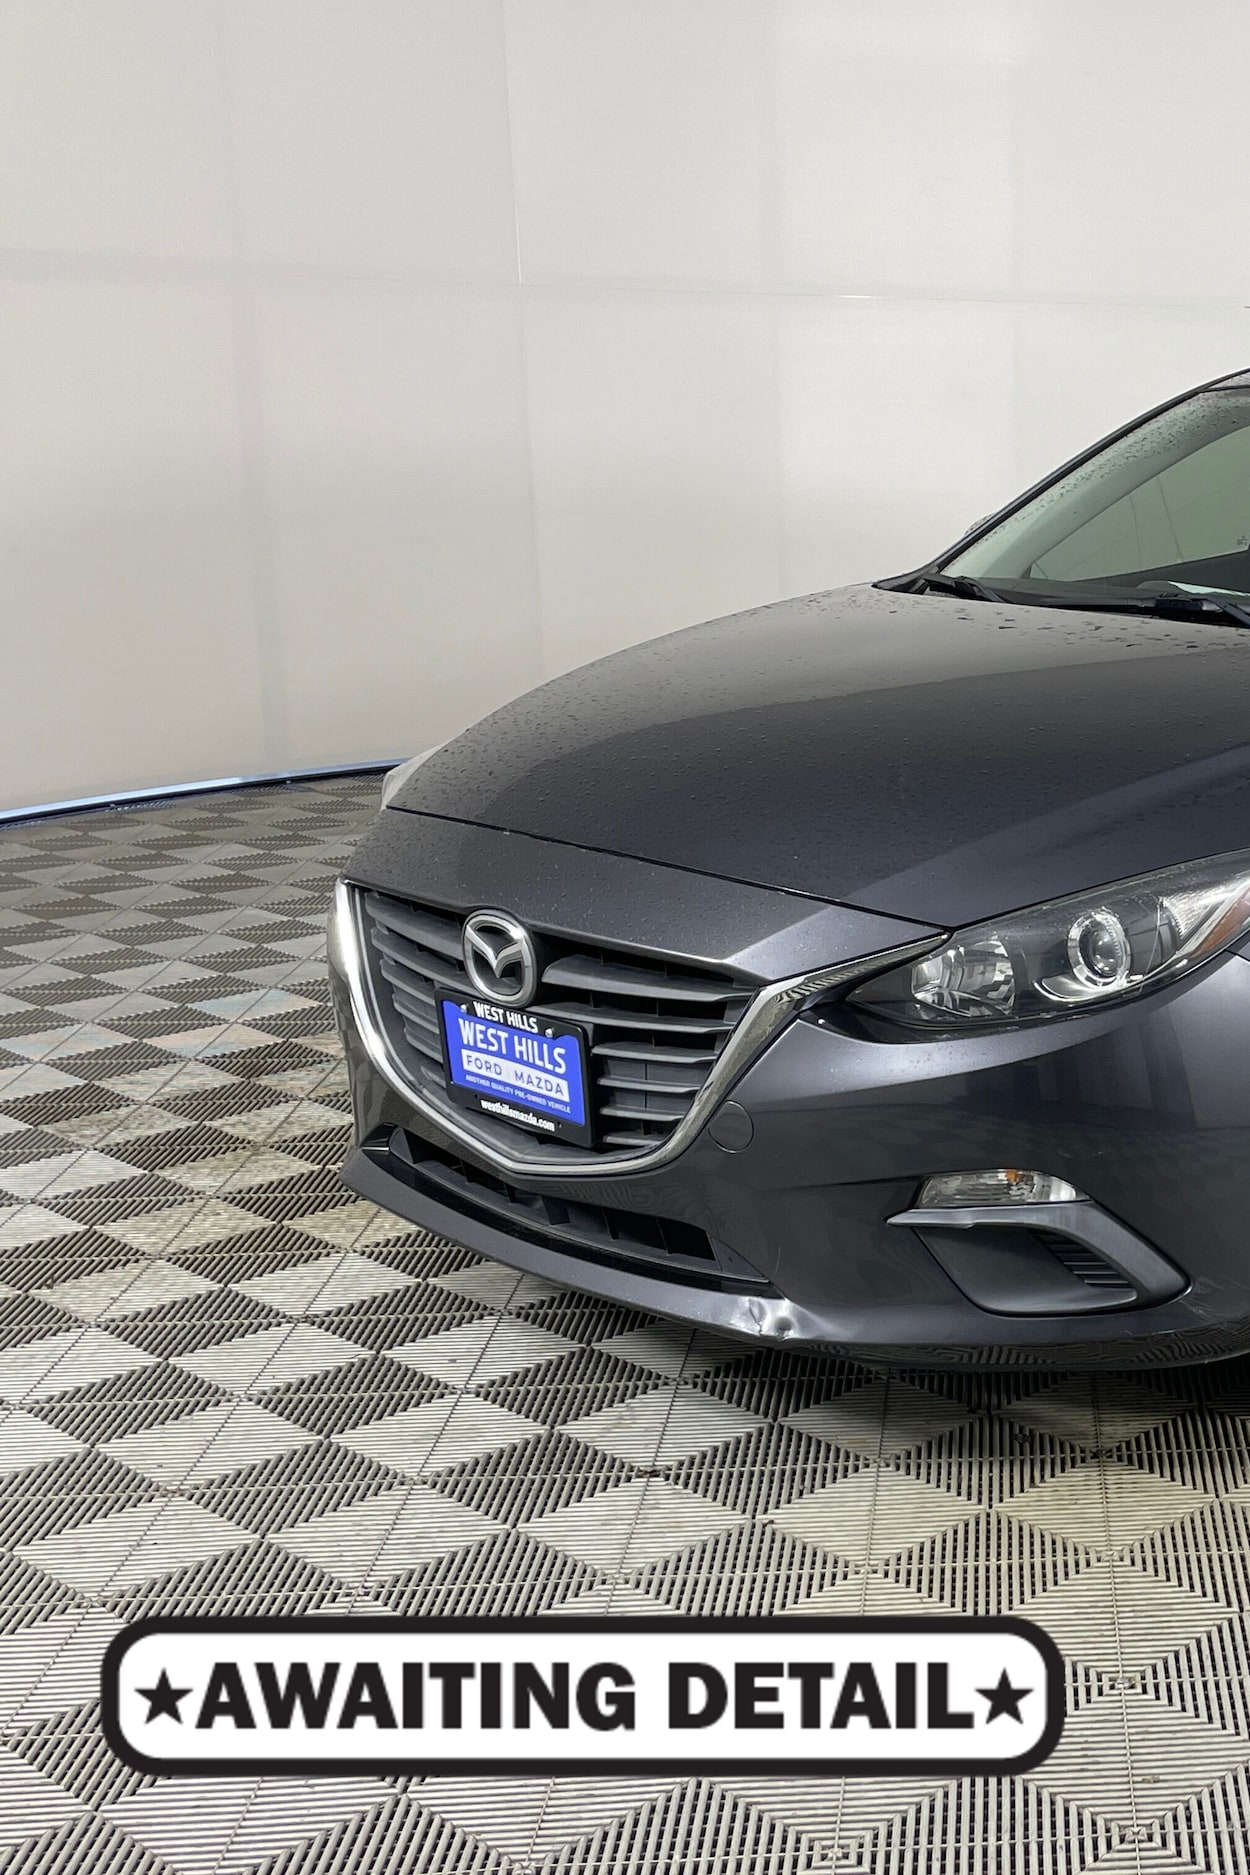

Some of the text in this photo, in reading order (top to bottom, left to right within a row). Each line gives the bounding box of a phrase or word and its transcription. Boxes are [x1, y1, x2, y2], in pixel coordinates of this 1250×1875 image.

[473, 1001, 538, 1034] WEST HILLS
[458, 1018, 567, 1075] WEST HILLS
[466, 1055, 564, 1097] FORD MAZDA
[480, 1099, 555, 1132] westhillsmazda.com
